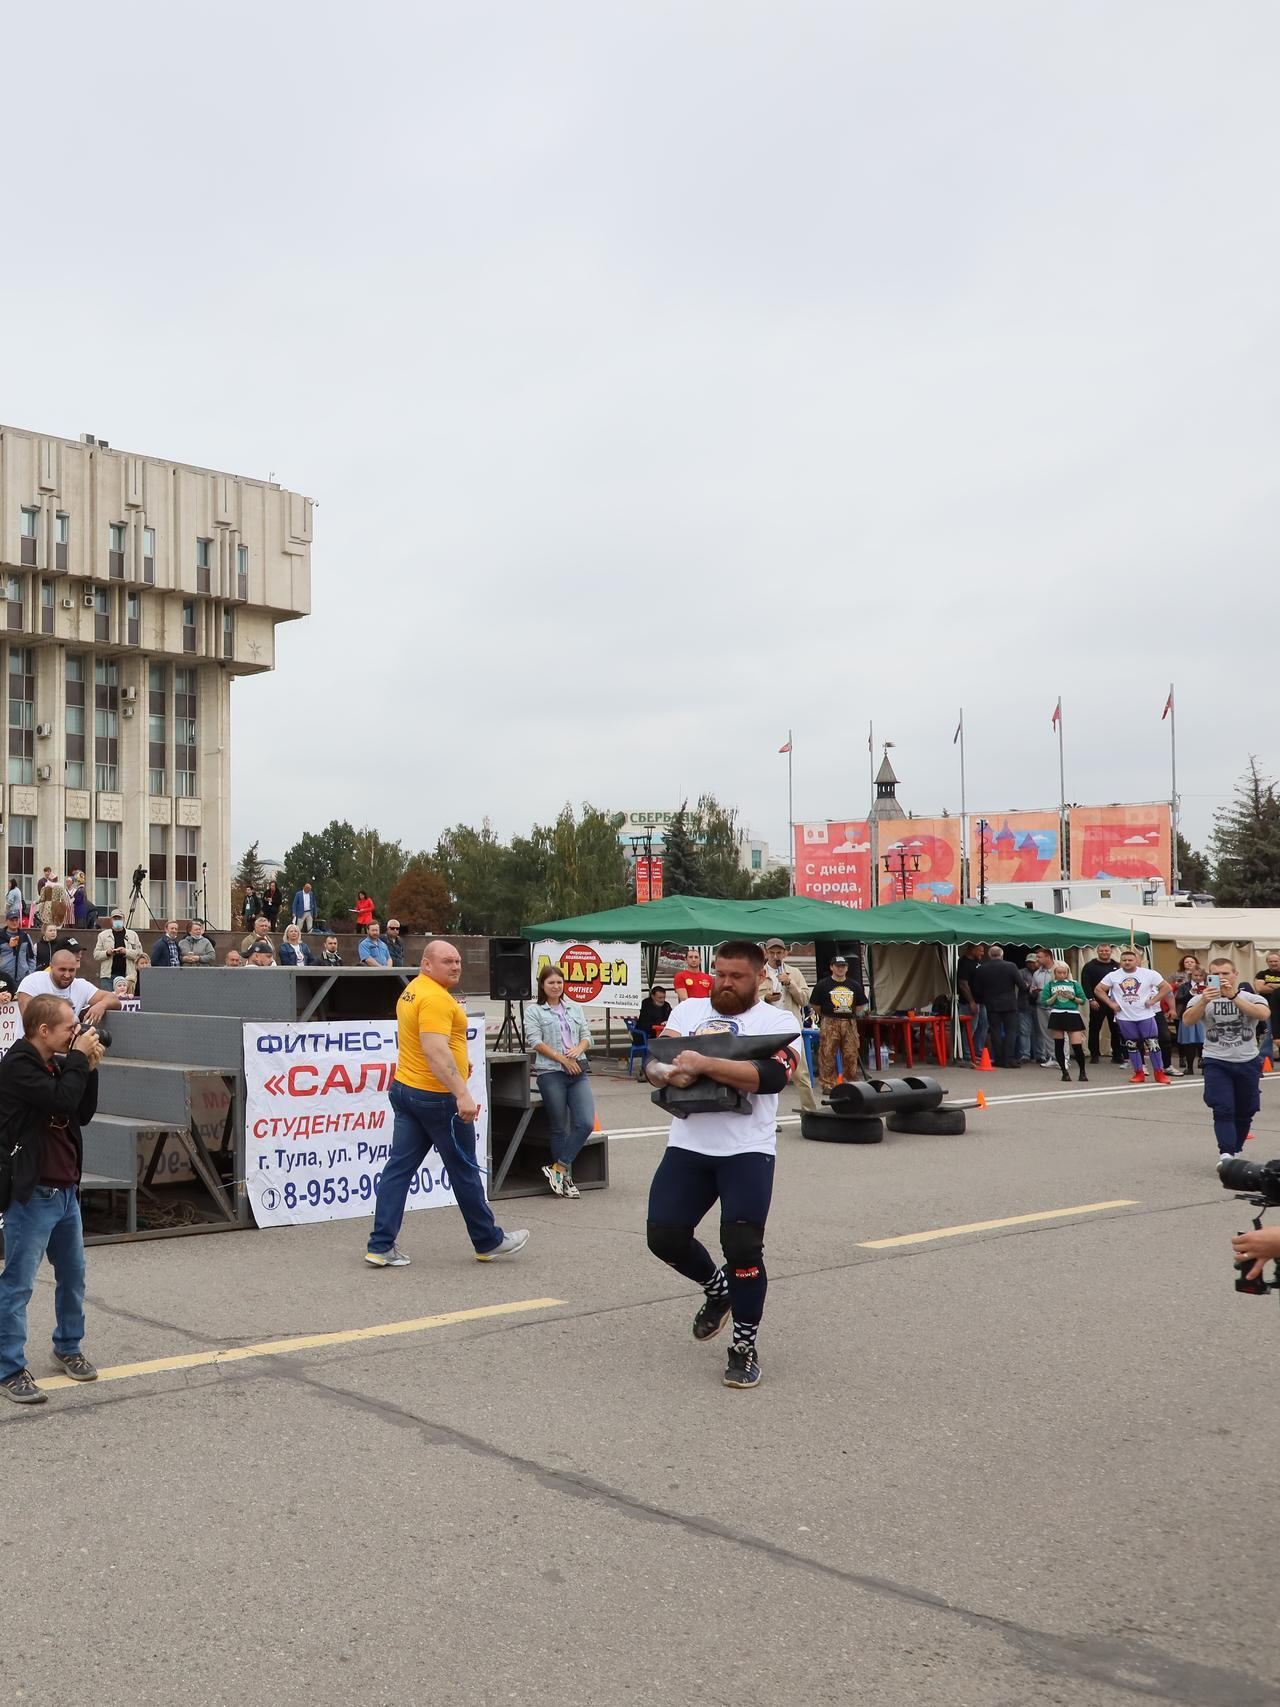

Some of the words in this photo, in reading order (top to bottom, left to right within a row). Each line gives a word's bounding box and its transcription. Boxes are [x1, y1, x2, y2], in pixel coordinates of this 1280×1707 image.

[805, 863, 815, 875] С
[820, 863, 856, 876] днём
[806, 882, 861, 895] города,
[568, 986, 594, 994] ФИТНЕС
[253, 1110, 386, 1141] СТУДЕНТАМ
[259, 1155, 270, 1169] г.
[275, 1148, 323, 1173] Тула,
[327, 1147, 352, 1169] ул.
